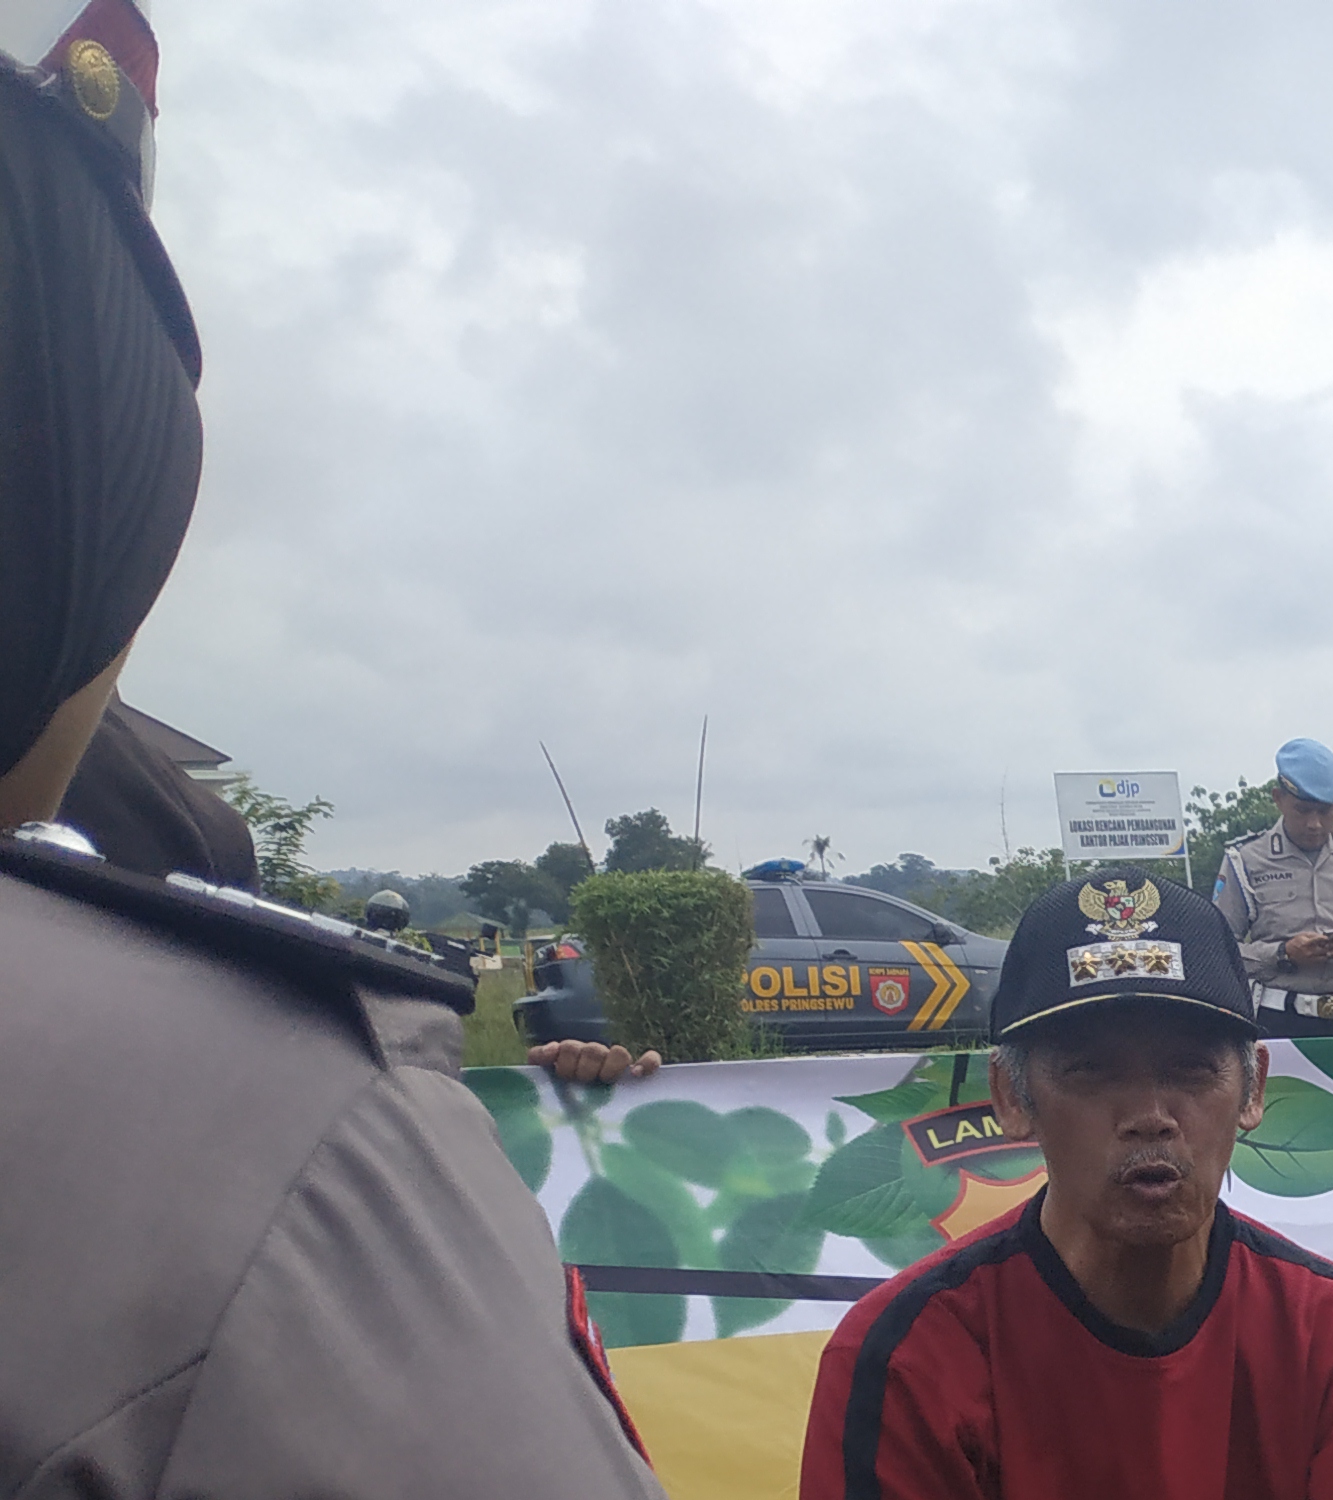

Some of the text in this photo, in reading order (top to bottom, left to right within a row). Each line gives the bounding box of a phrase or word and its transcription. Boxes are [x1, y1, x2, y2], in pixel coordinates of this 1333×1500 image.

[1117, 780, 1140, 798] djp
[1069, 818, 1177, 833] LOKASI RENCANA PEMBANGUNAN
[1080, 833, 1169, 847] KANTOR PAJAK PRINGSEWU
[1253, 872, 1293, 884] KOHAR
[740, 965, 862, 998] OLISI
[741, 997, 855, 1013] OLRES PRINGSEWU
